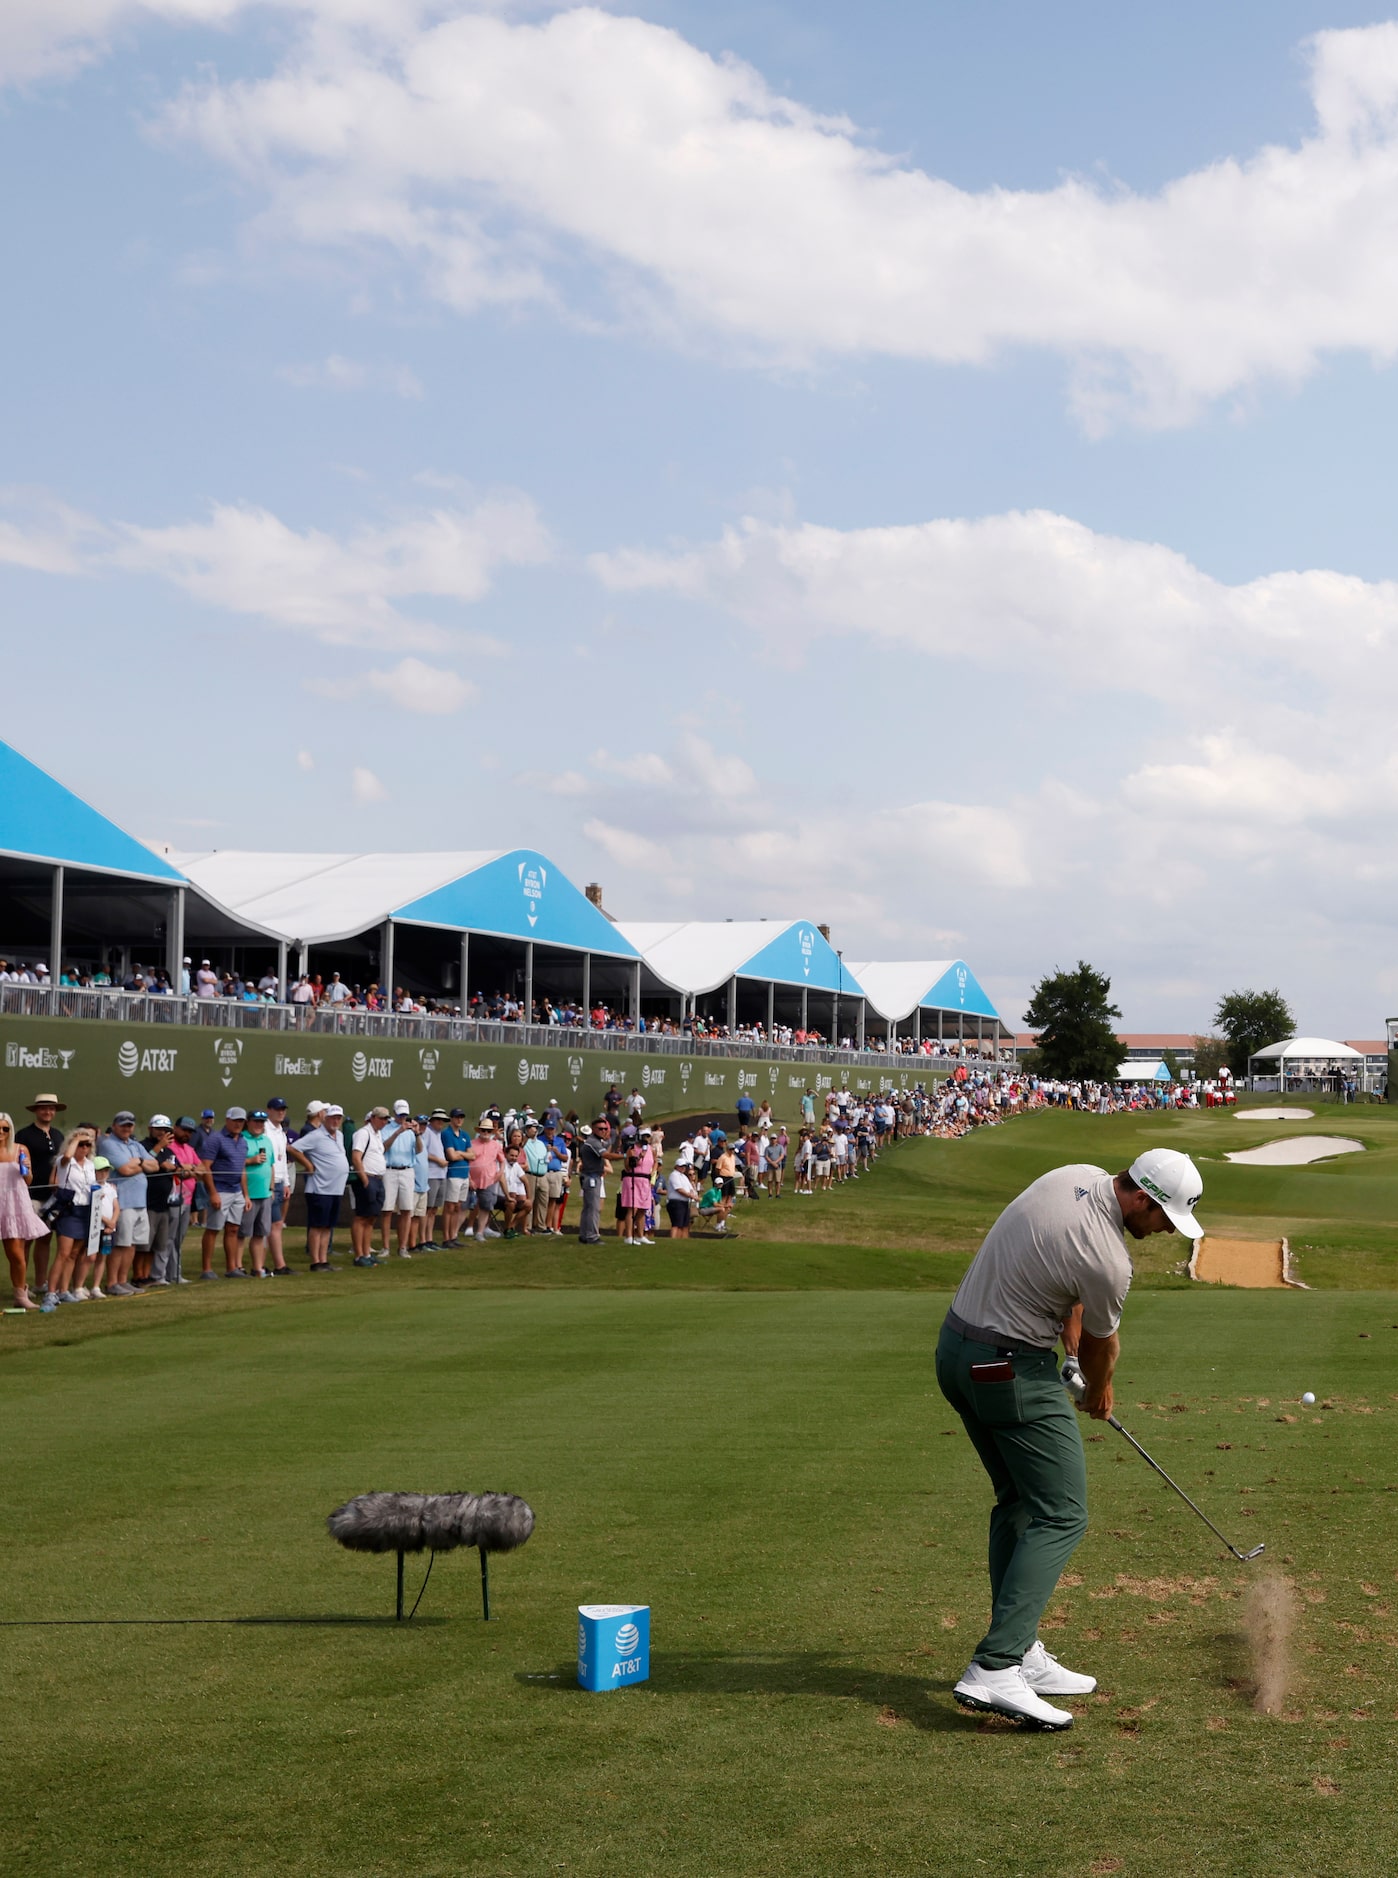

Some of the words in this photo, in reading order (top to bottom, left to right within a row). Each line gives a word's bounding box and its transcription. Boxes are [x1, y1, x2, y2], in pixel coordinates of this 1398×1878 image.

[19, 1047, 58, 1069] FedEx
[140, 1049, 178, 1071] AT&T
[283, 1058, 311, 1075] FedEx
[368, 1058, 394, 1077] AT&T
[530, 1064, 549, 1081] AT&T
[650, 1070, 666, 1084] AT&T
[1140, 1176, 1172, 1203] EPIC
[611, 1656, 641, 1678] AT&T
